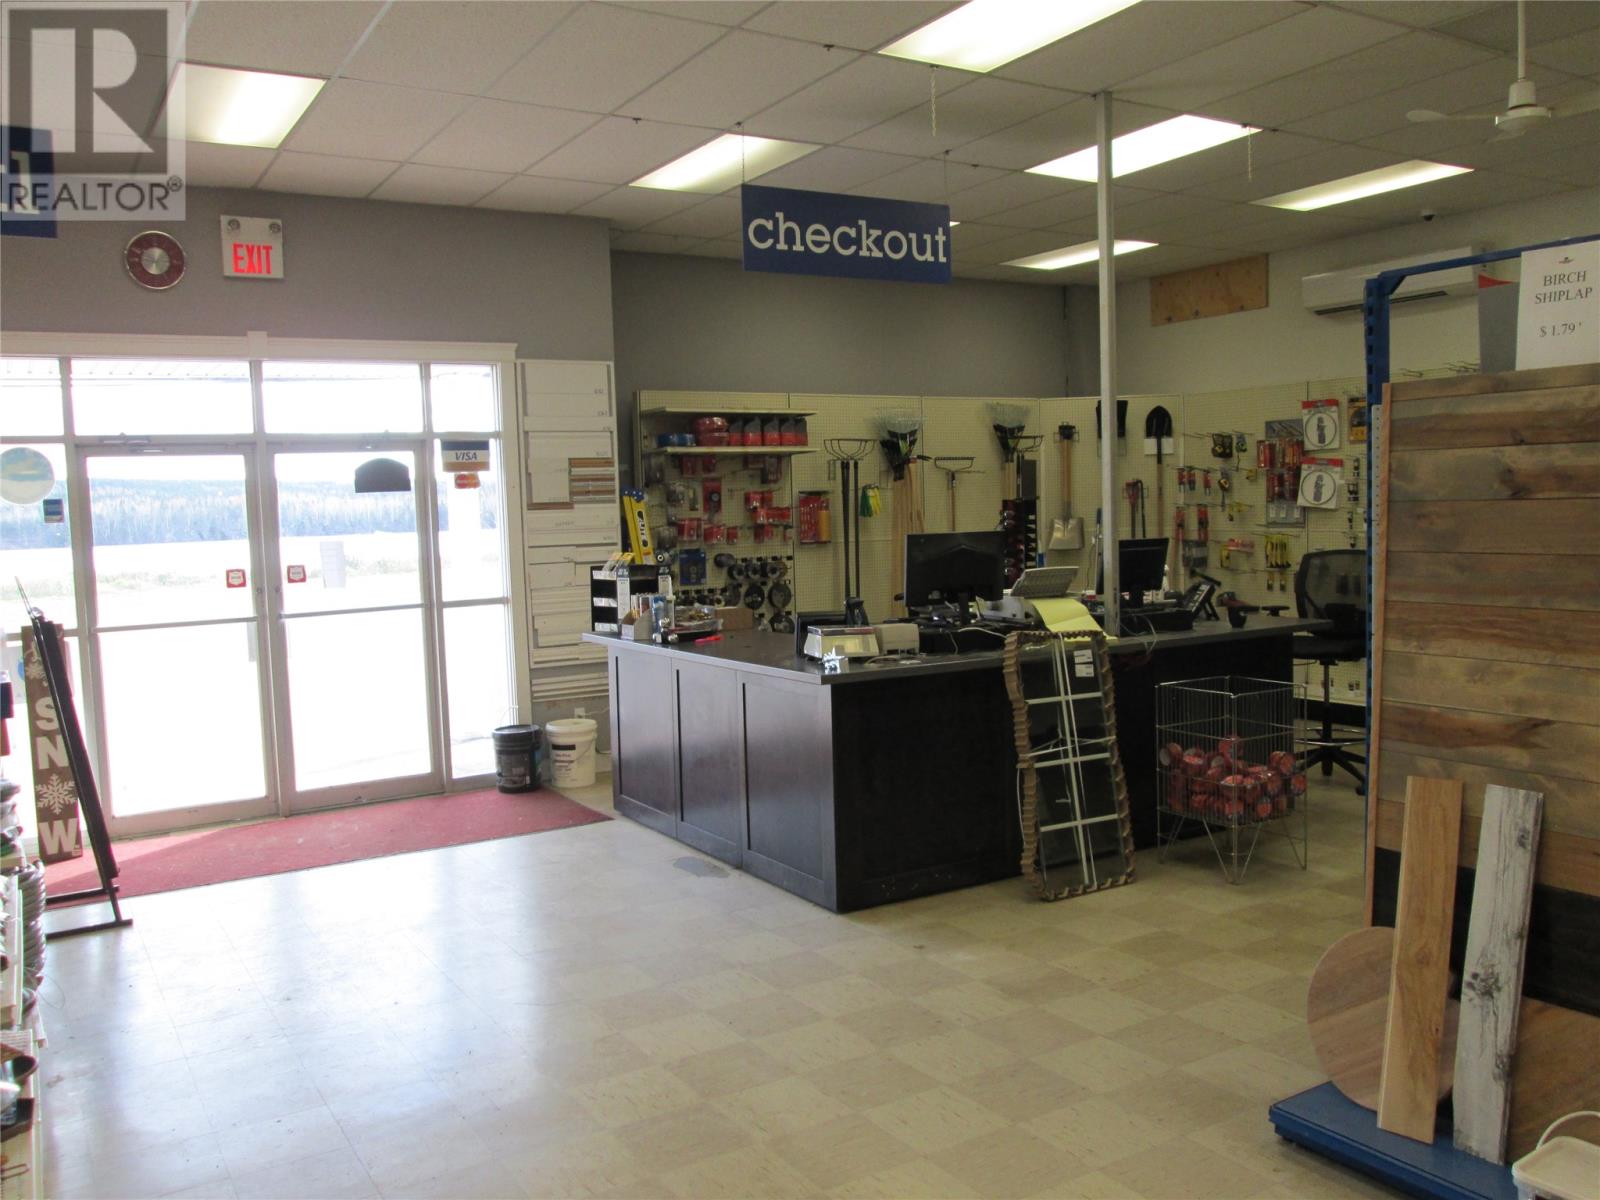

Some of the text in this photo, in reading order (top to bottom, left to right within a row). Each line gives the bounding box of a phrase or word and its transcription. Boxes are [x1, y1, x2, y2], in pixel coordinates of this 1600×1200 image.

[748, 211, 947, 263] checkout
[232, 242, 272, 275] EXIT
[1543, 270, 1587, 287] BIRCH
[1534, 287, 1593, 305] SHIPLAP
[455, 451, 478, 461] VISA
